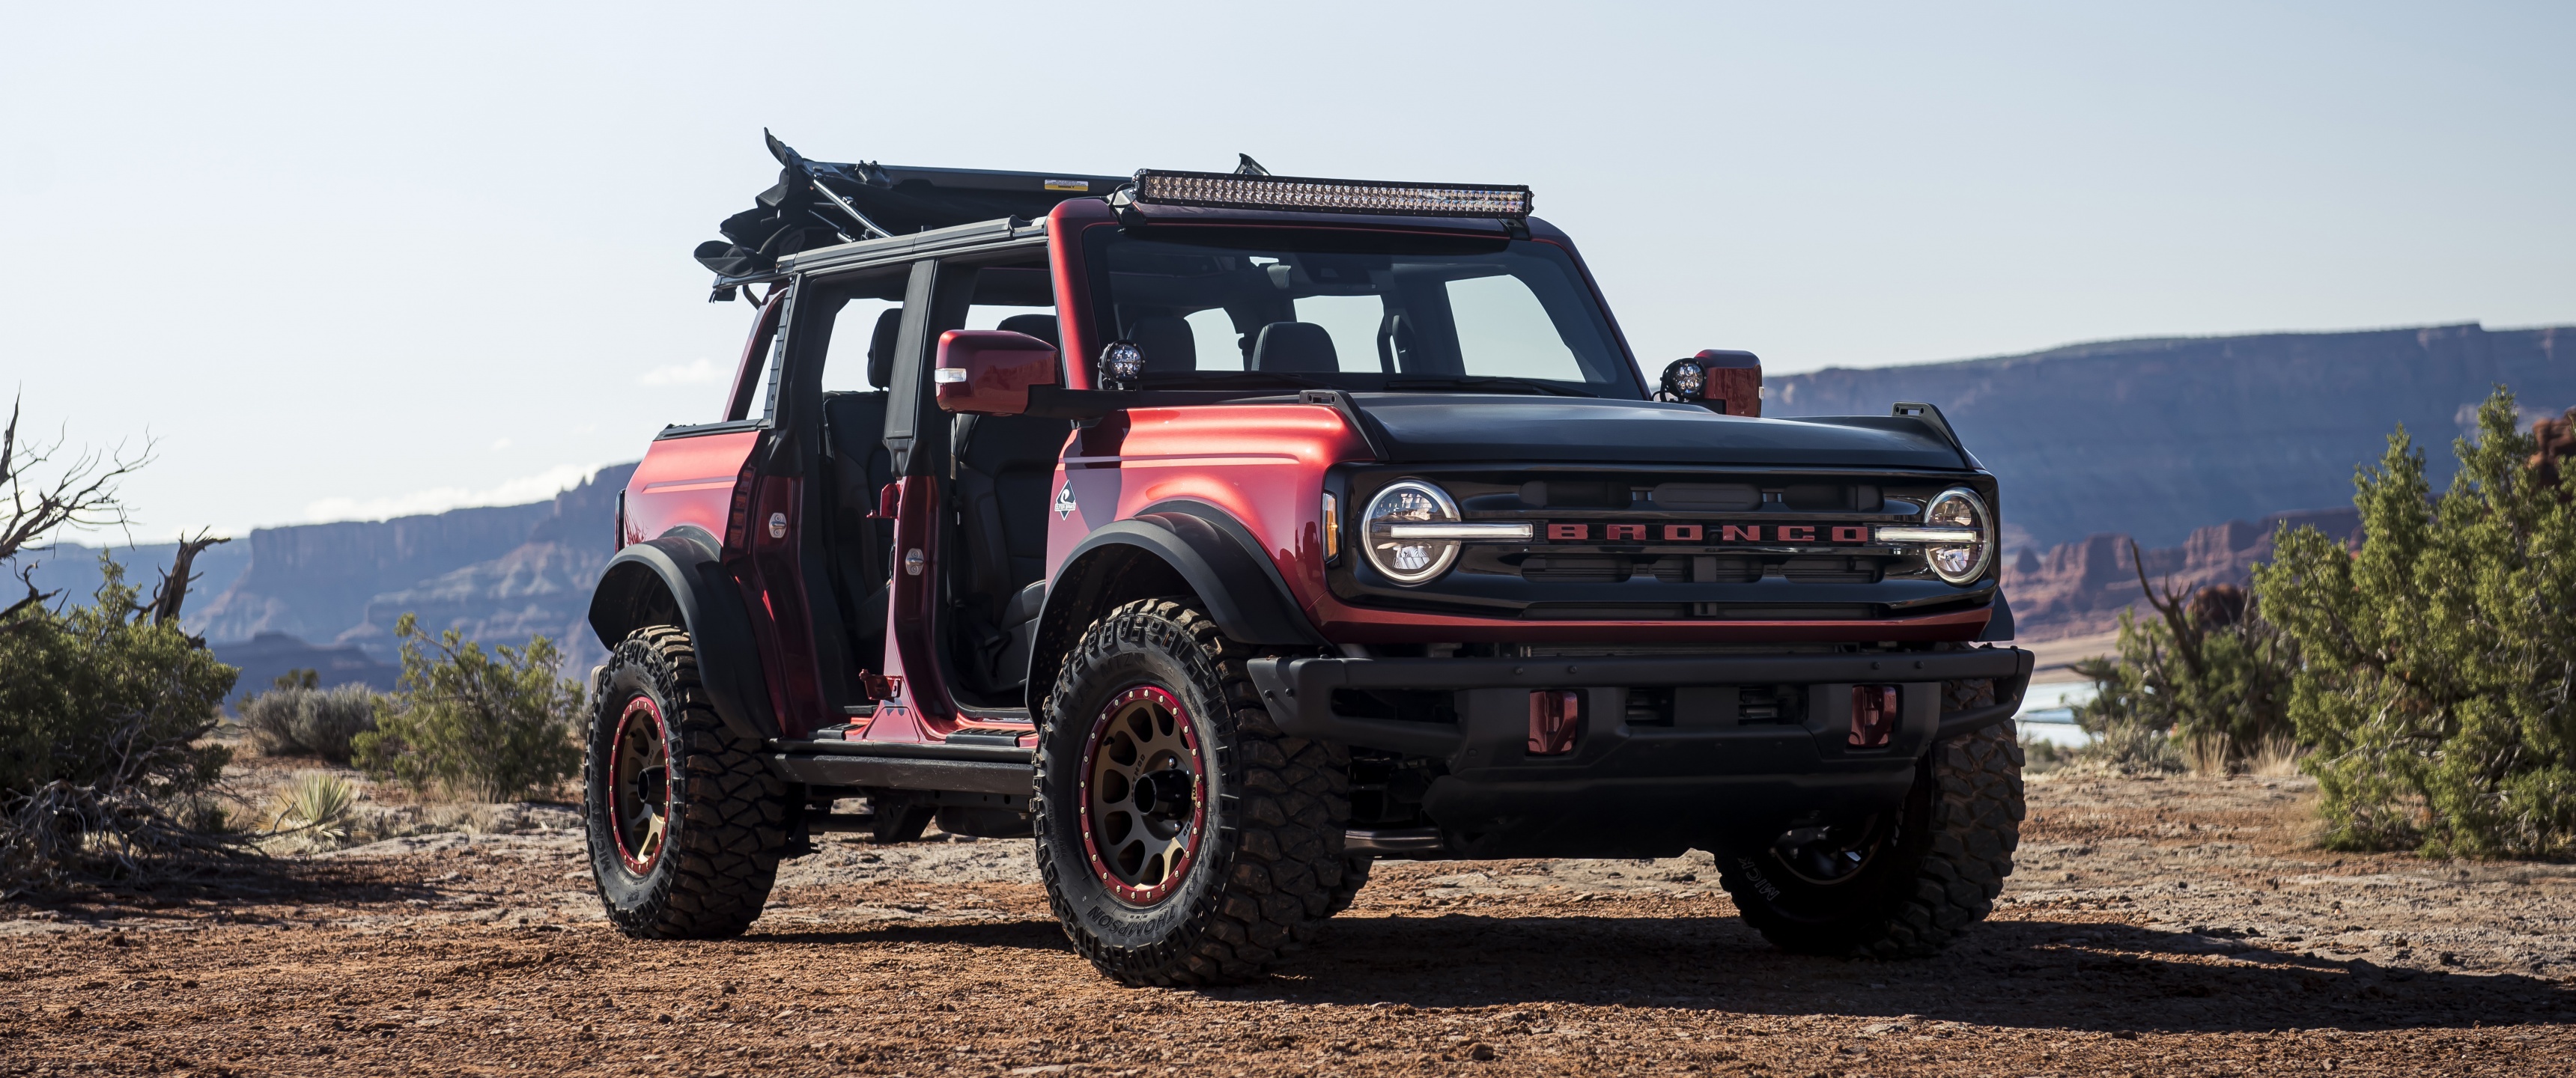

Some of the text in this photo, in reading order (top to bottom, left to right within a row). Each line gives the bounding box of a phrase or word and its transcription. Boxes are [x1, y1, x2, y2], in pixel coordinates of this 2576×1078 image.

[1548, 524, 1868, 542] BRONCO
[592, 797, 612, 873] MICKEY
[1086, 903, 1176, 937] THOMPSON
